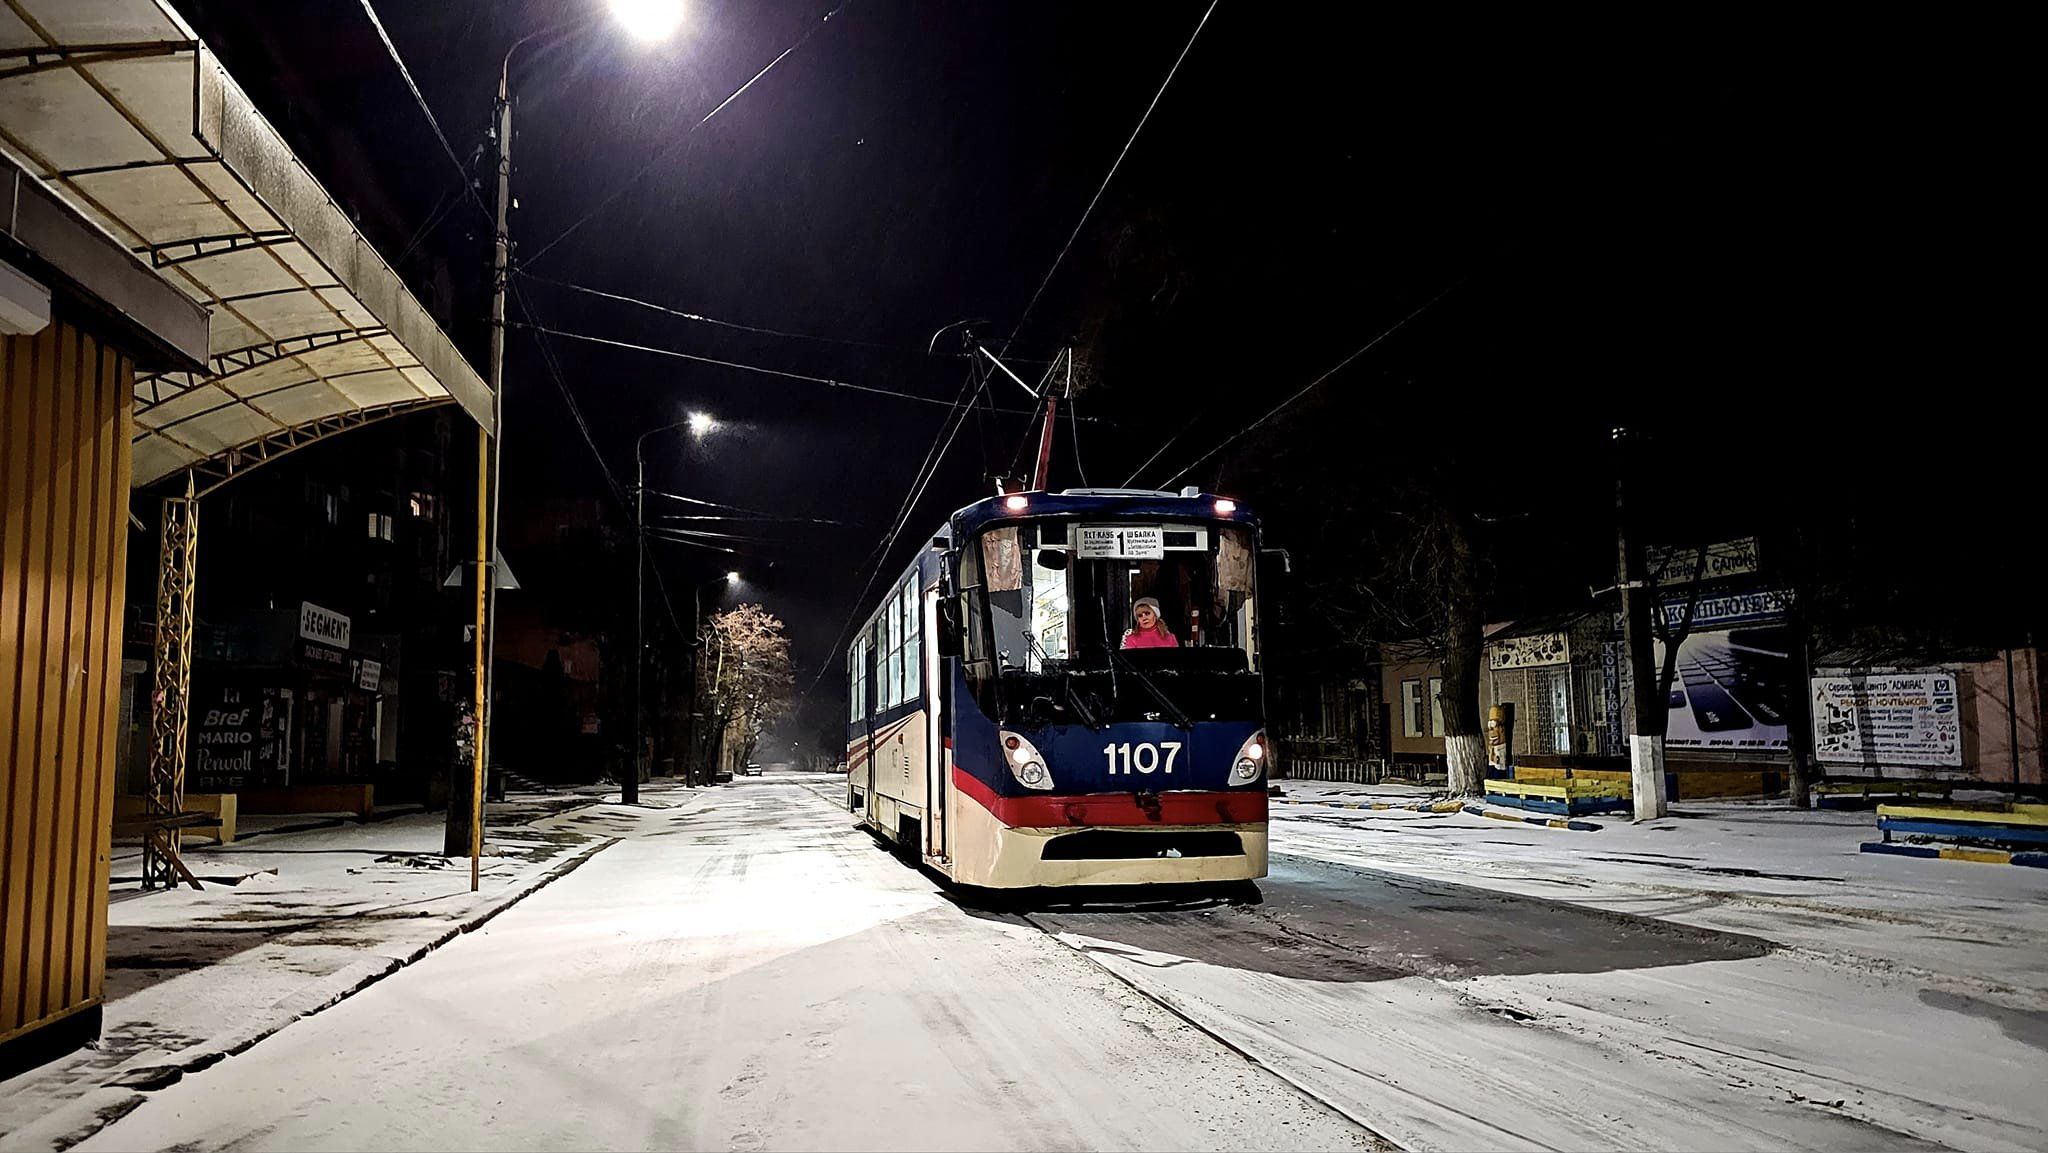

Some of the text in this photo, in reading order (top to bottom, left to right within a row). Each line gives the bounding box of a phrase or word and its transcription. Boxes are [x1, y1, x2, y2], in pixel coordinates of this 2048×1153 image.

[1116, 531, 1125, 556] 1
[304, 609, 348, 641] SEGMENT
[203, 708, 250, 727] Bref
[197, 732, 253, 744] MARIO
[1103, 742, 1182, 775] 1107
